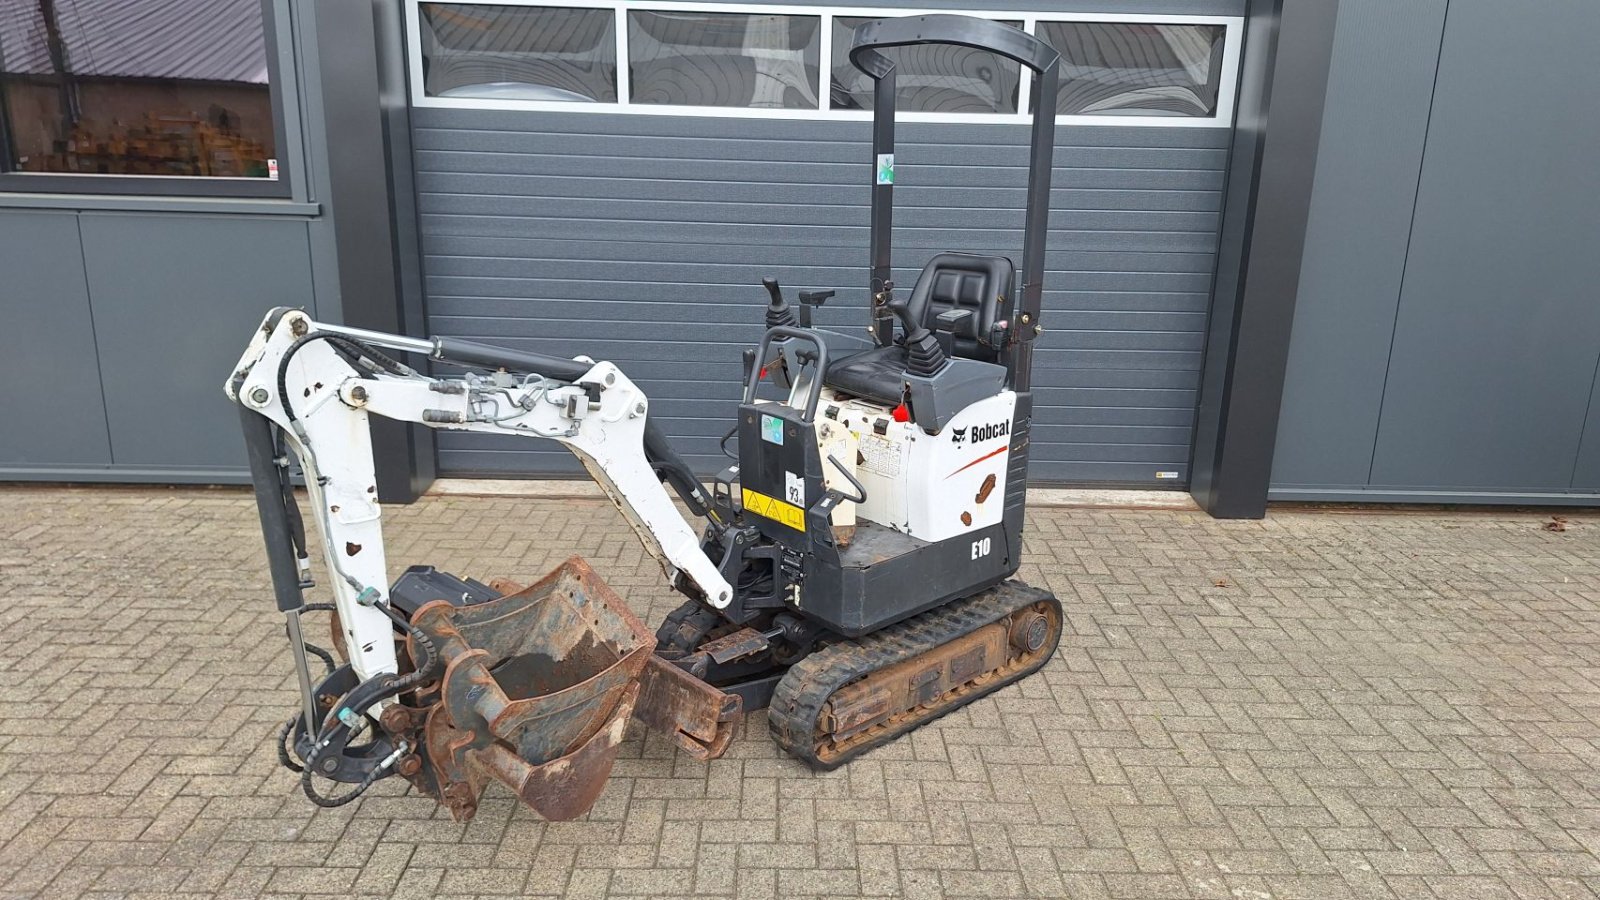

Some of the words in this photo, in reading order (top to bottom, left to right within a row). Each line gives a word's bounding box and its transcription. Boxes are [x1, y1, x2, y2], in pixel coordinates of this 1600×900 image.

[971, 419, 1010, 444] Bobcat
[790, 486, 799, 503] 93
[971, 537, 991, 560] E10
